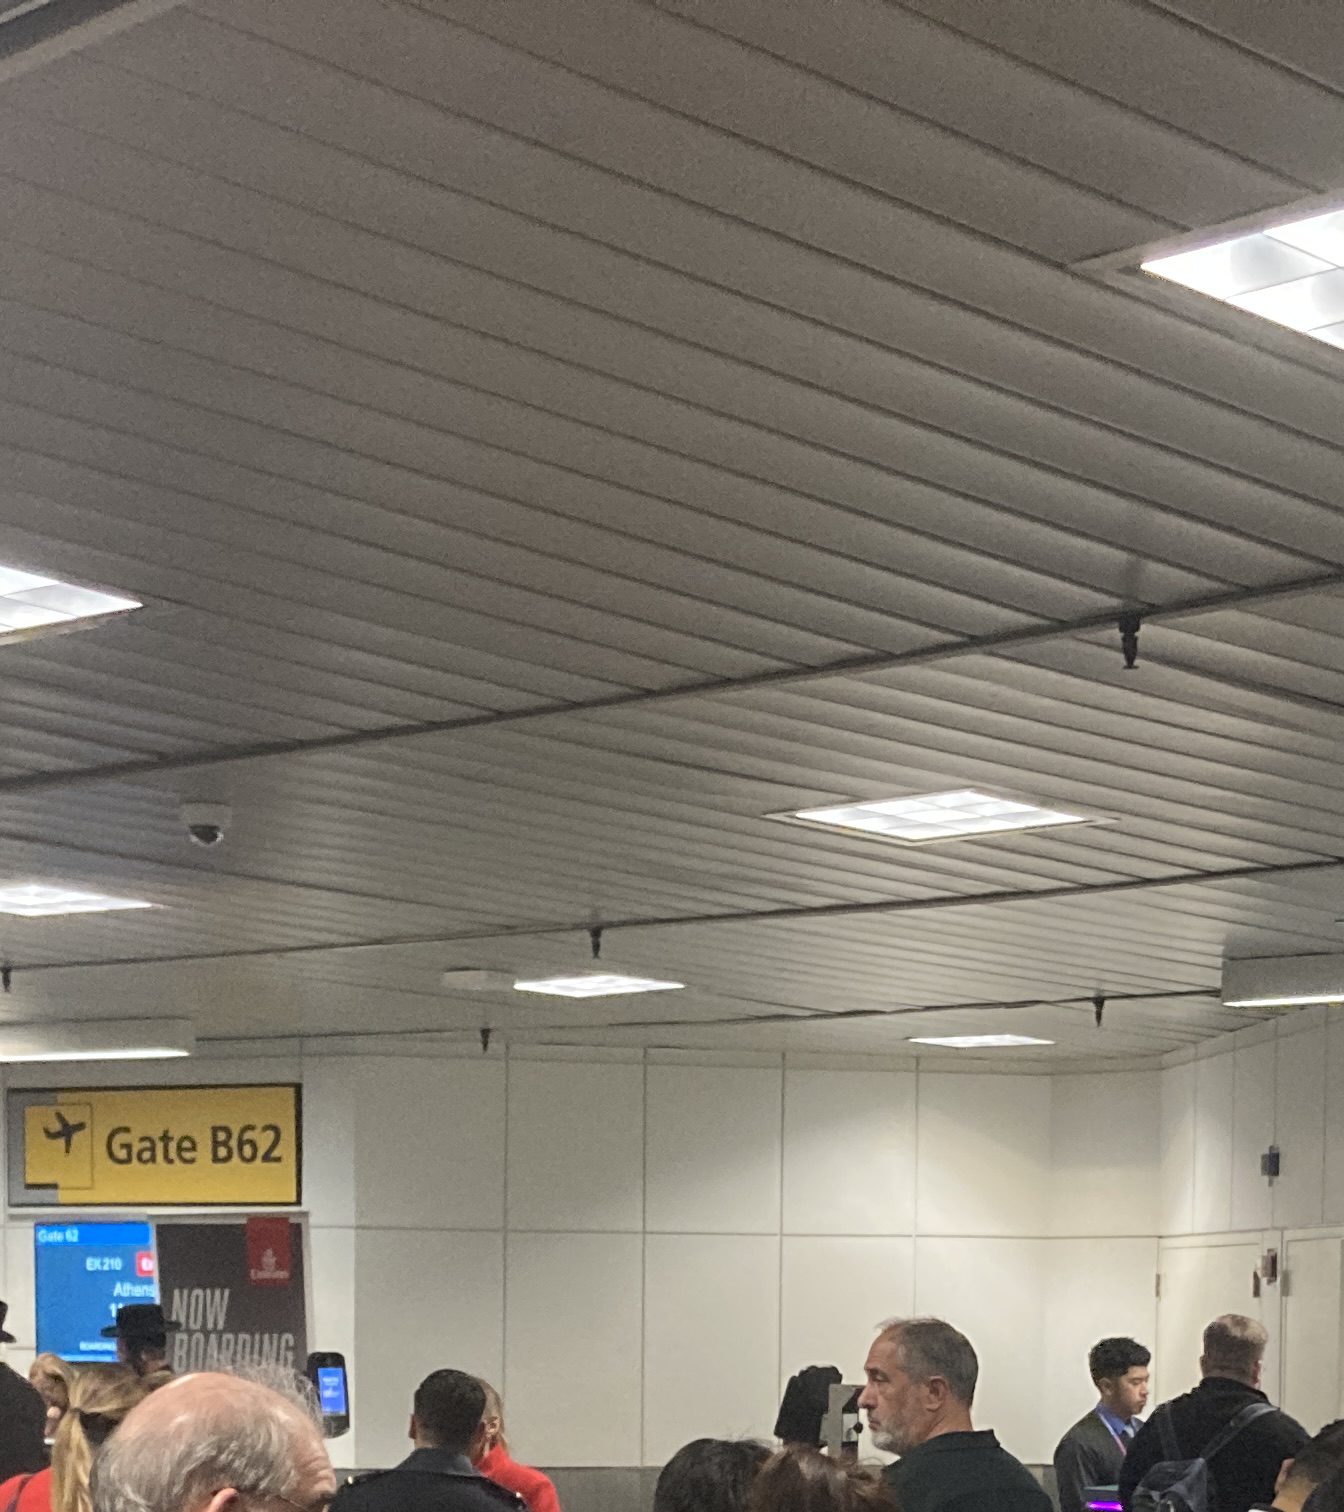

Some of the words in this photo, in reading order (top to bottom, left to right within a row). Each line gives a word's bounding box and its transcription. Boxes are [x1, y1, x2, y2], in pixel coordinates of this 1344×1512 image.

[106, 1126, 197, 1166] Gate
[211, 1124, 283, 1164] B62
[38, 1229, 65, 1243] Gate
[65, 1229, 79, 1243] 62
[85, 1257, 102, 1271] EK
[102, 1257, 123, 1271] 210
[113, 1282, 156, 1298] Athens
[171, 1287, 231, 1332] NOW
[173, 1331, 296, 1372] BOARDING
